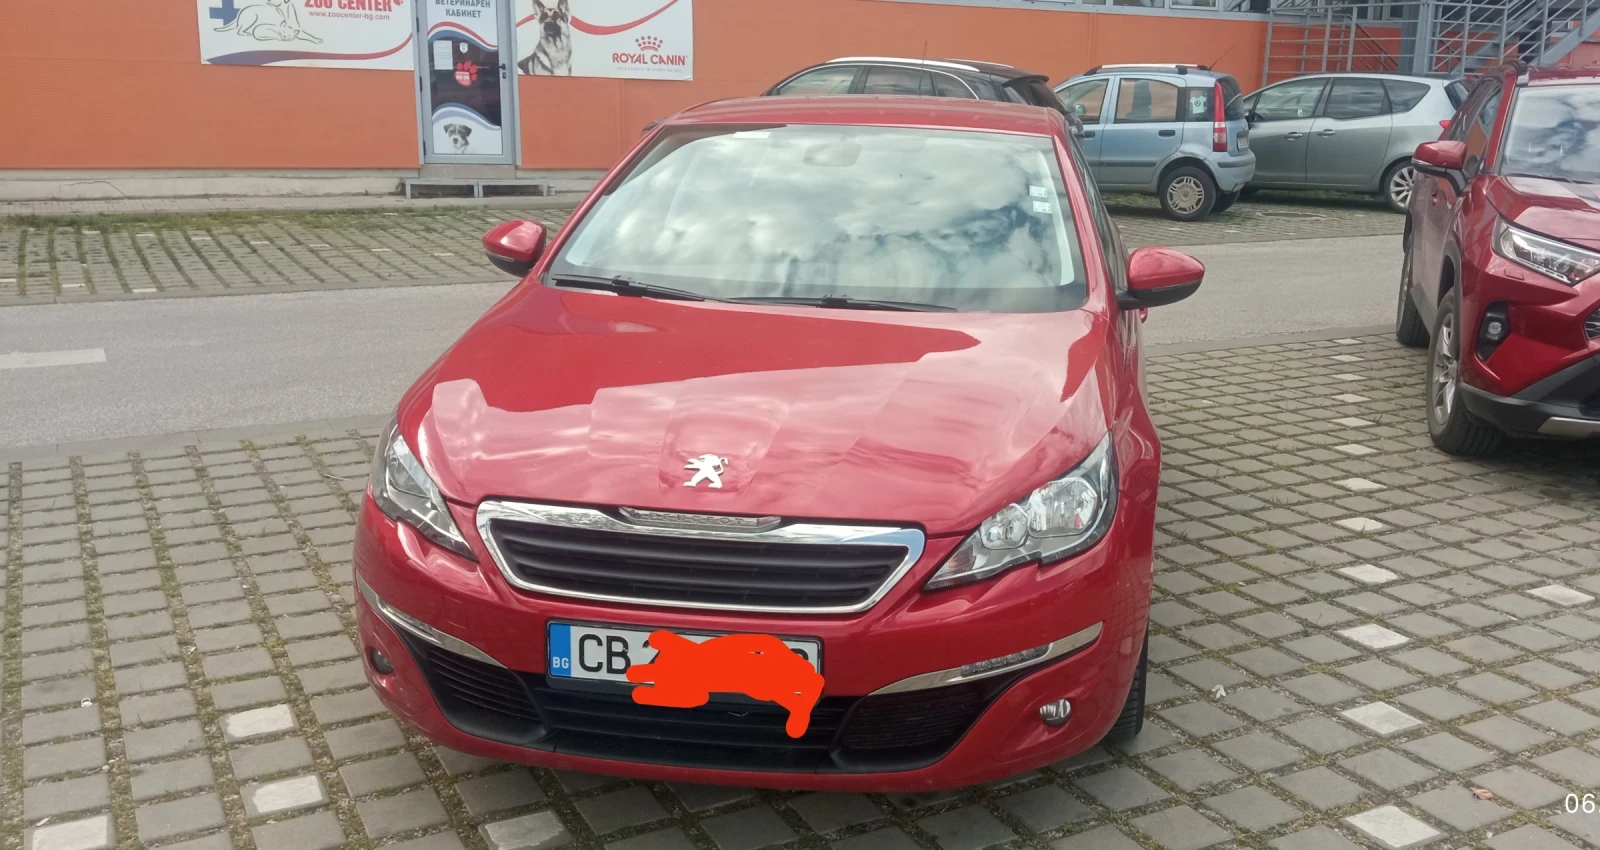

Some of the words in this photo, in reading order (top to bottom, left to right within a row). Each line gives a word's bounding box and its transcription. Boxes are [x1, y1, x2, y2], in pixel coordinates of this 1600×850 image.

[338, 0, 392, 12] CENTER
[308, 11, 390, 20] www.zoocenter-bg.com
[445, 9, 482, 18] КАБИНЕТ
[612, 53, 648, 64] ROYAL
[552, 656, 570, 669] BG
